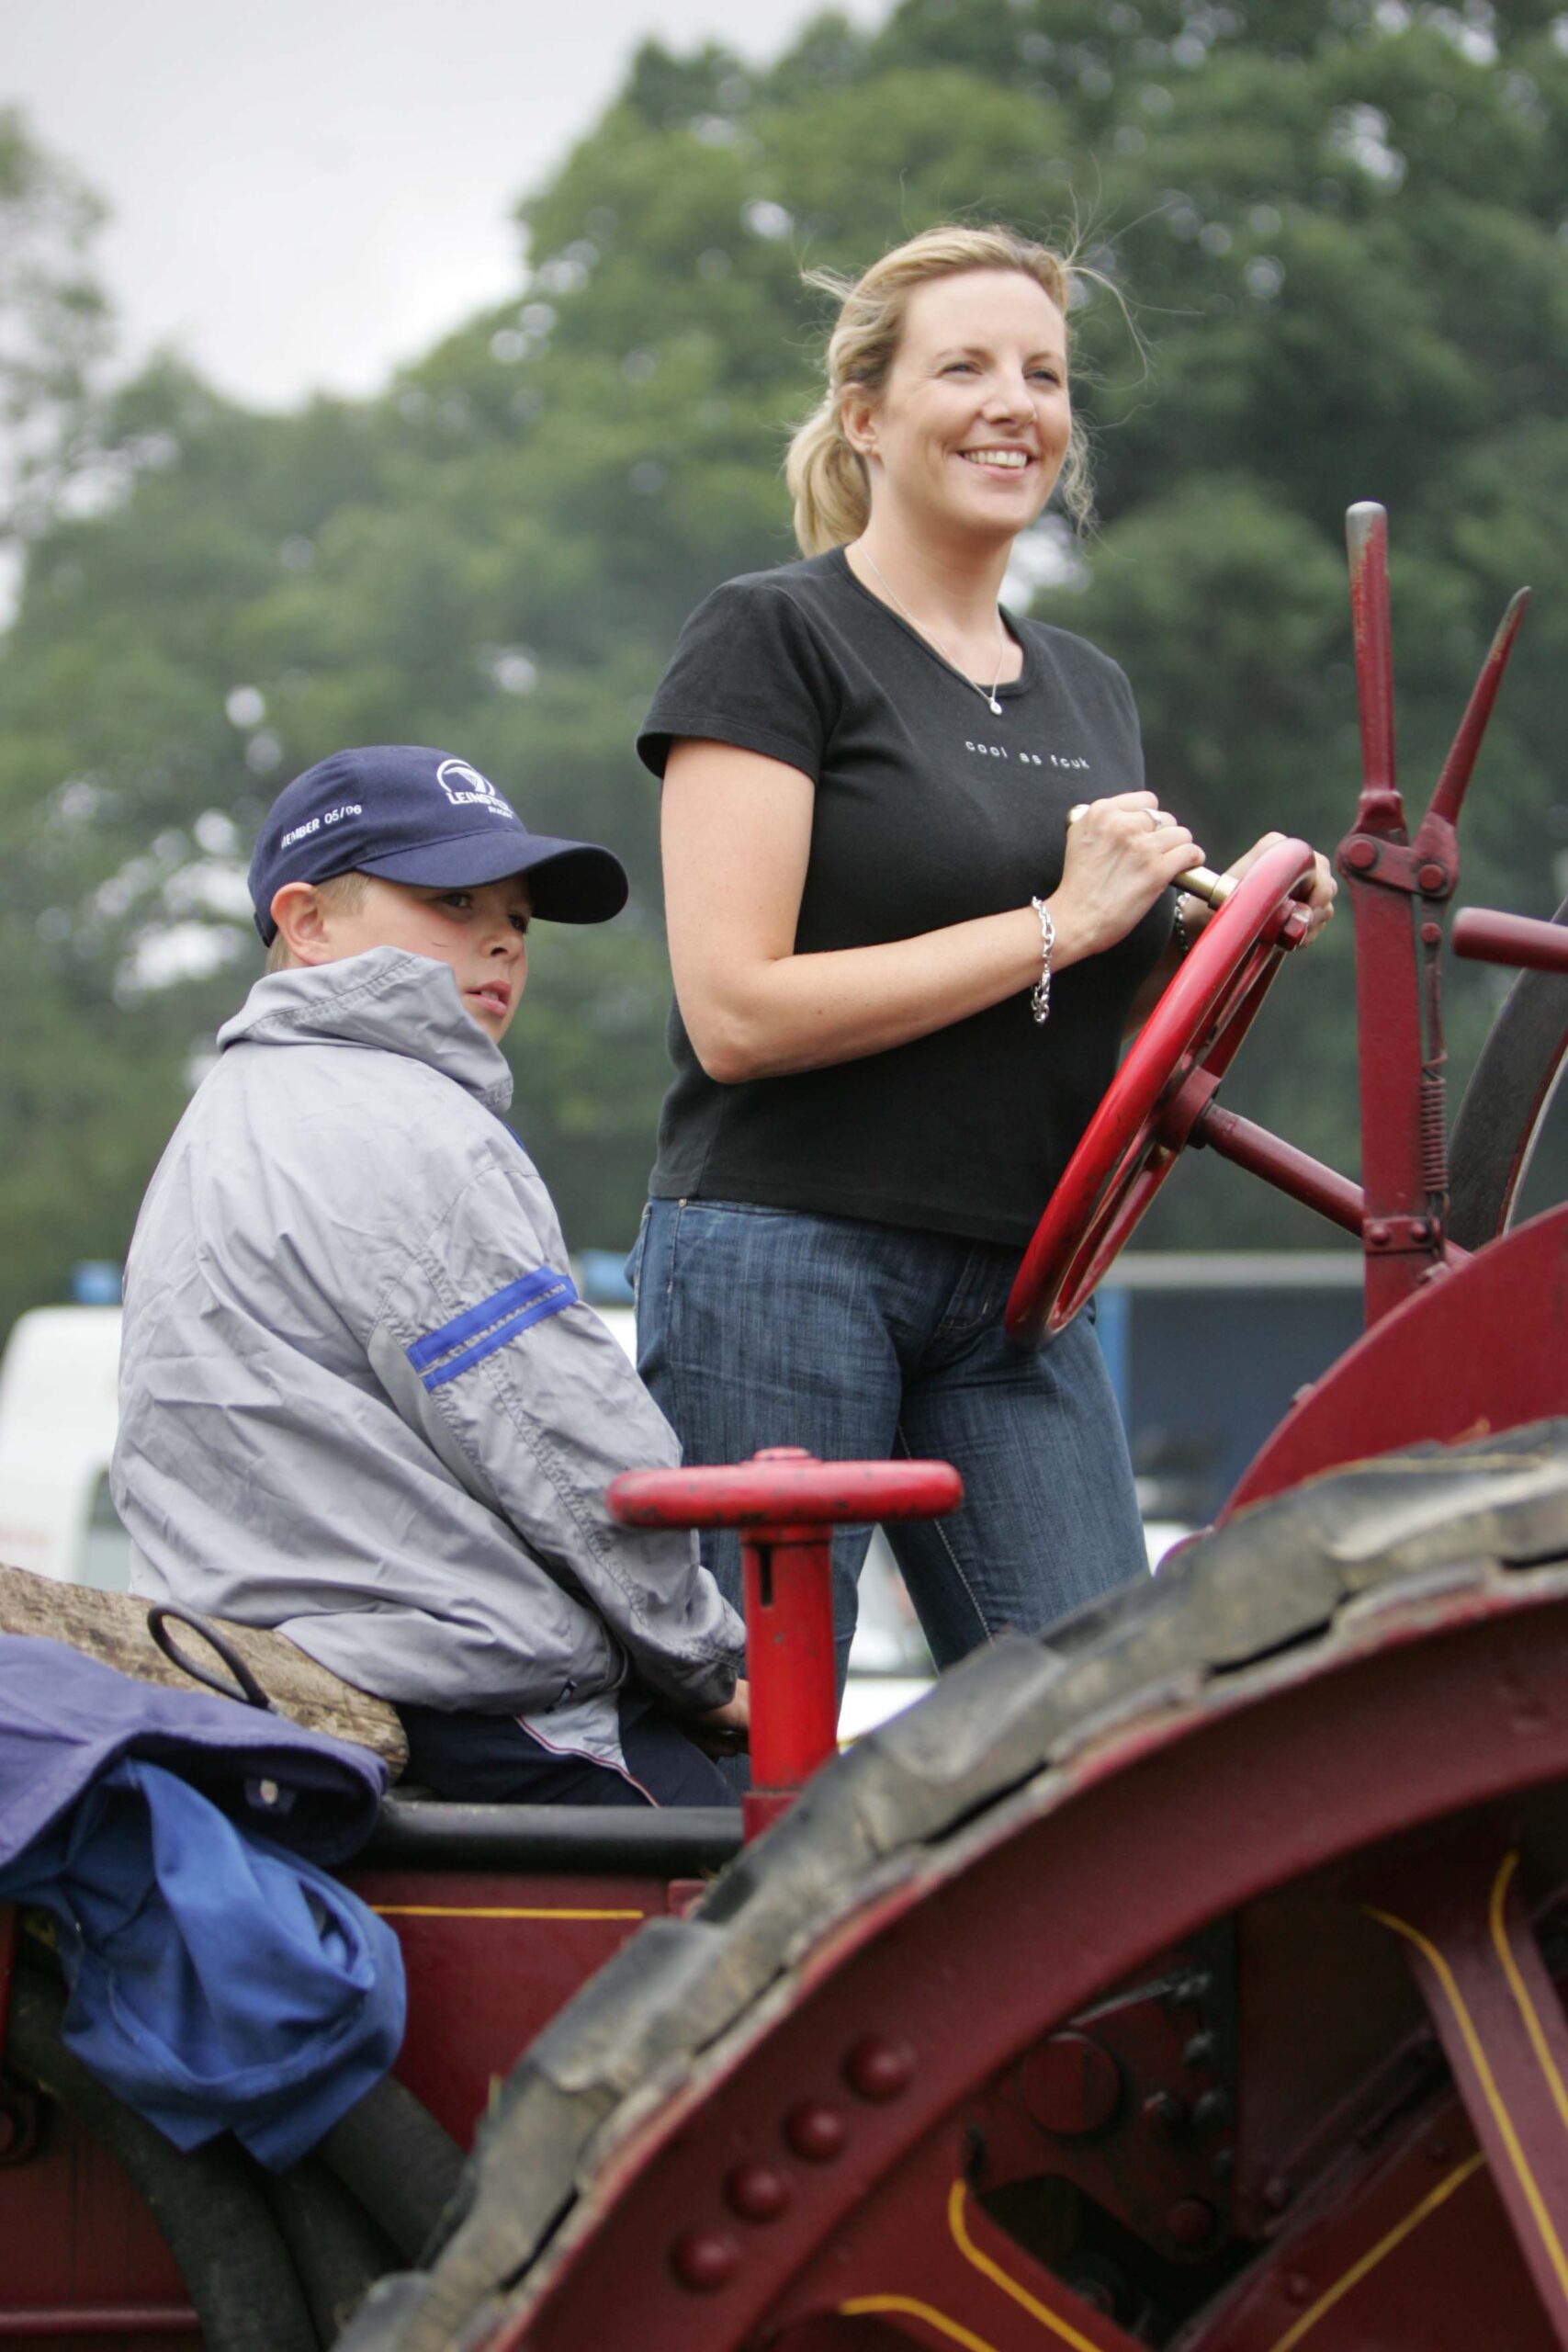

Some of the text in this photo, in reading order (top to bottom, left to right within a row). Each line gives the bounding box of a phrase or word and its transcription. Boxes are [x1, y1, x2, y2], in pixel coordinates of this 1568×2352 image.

[965, 741, 1089, 769] cool as fcuk
[324, 805, 362, 824] 05/06
